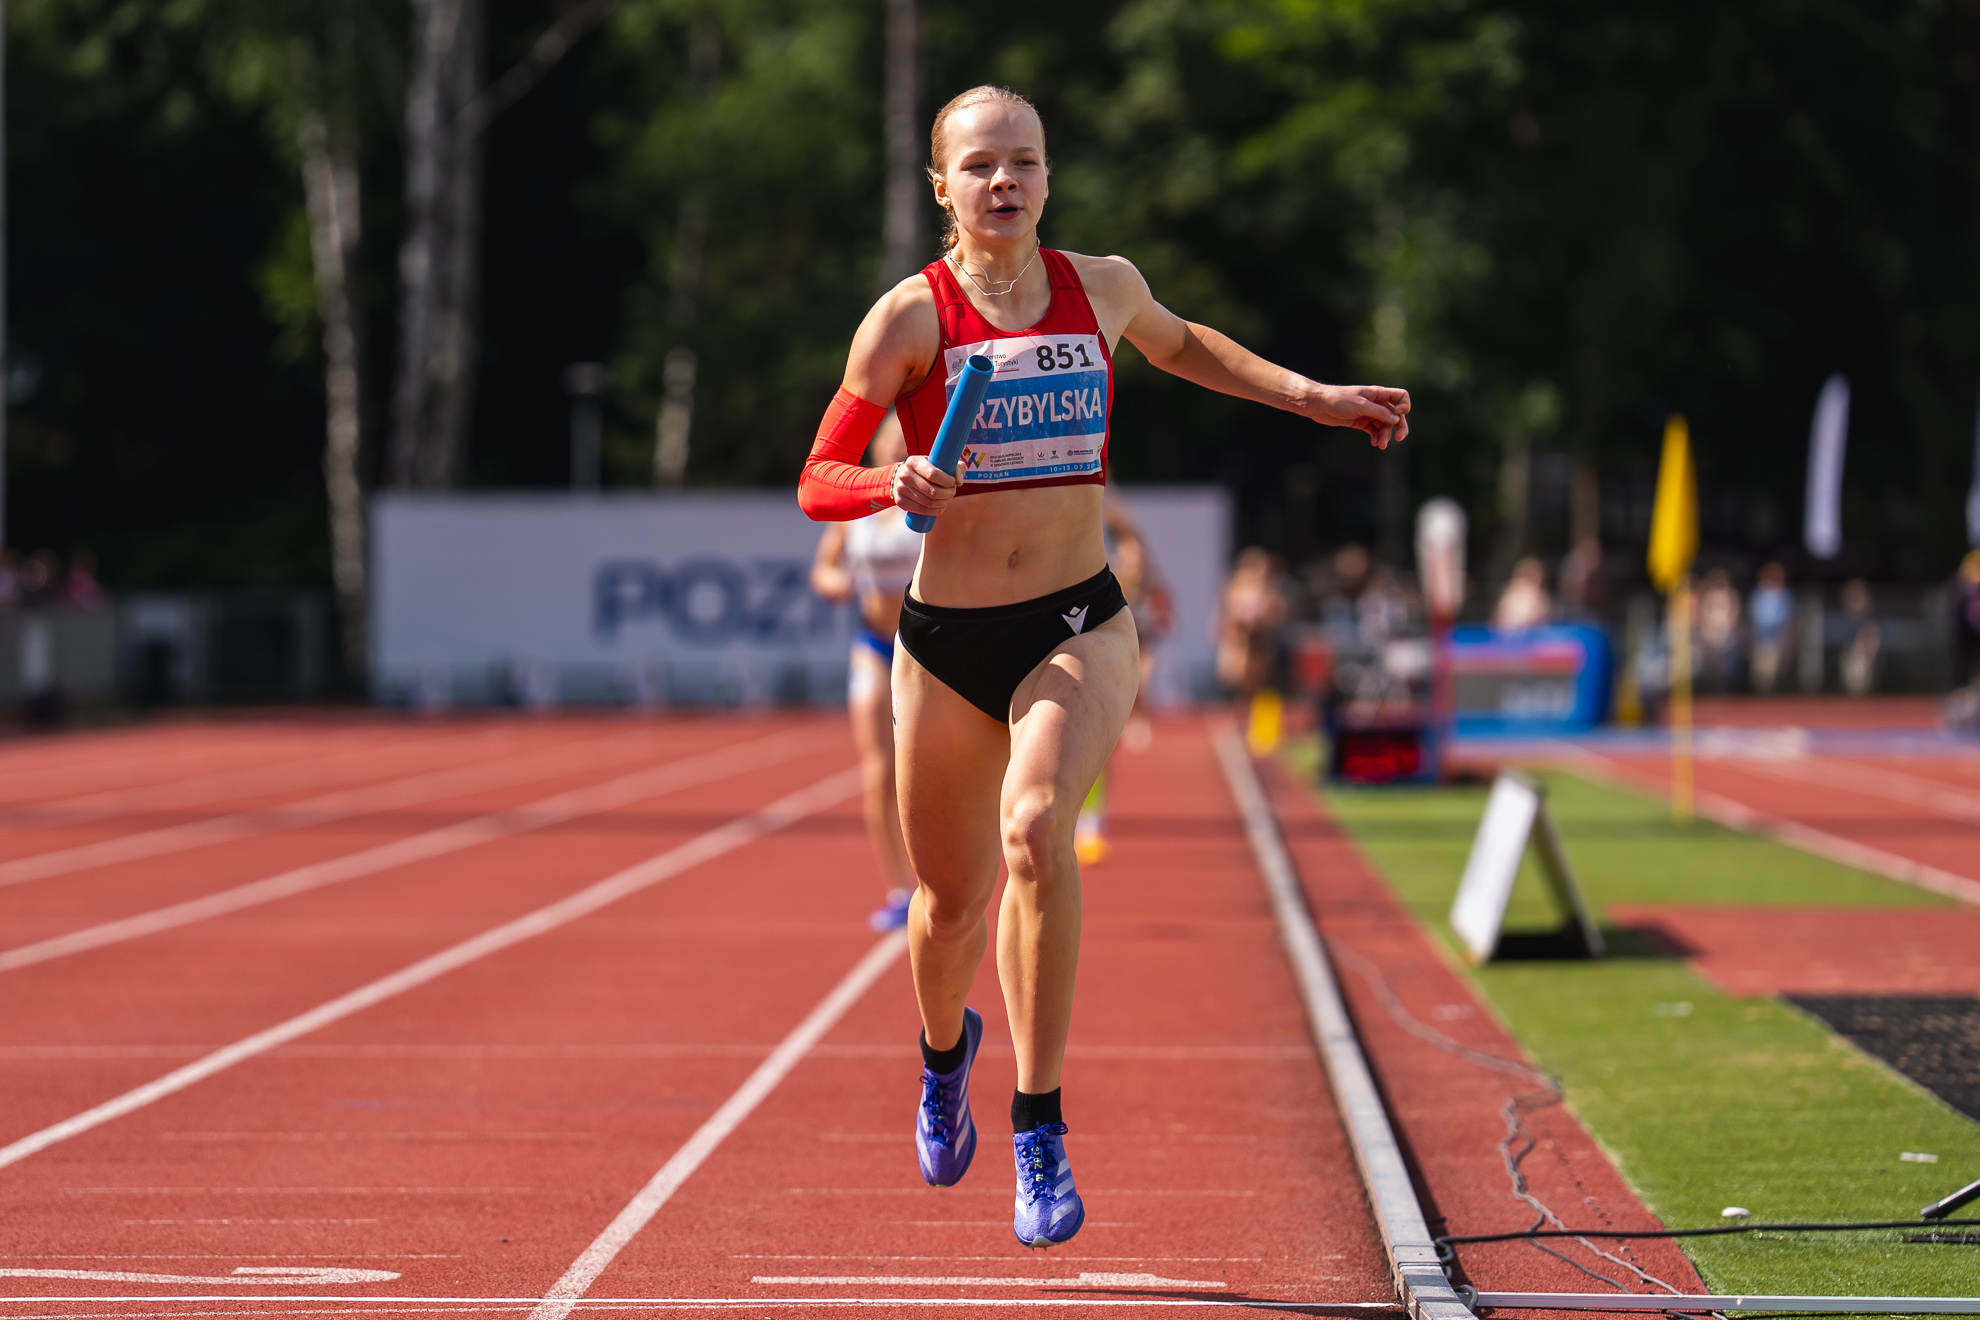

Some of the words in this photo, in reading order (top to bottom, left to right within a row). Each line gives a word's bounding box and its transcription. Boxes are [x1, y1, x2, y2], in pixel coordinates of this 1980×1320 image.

[1036, 343, 1094, 371] 851
[972, 388, 1102, 429] RZYBYLSKA
[1049, 463, 1096, 472] 10-13.07.2
